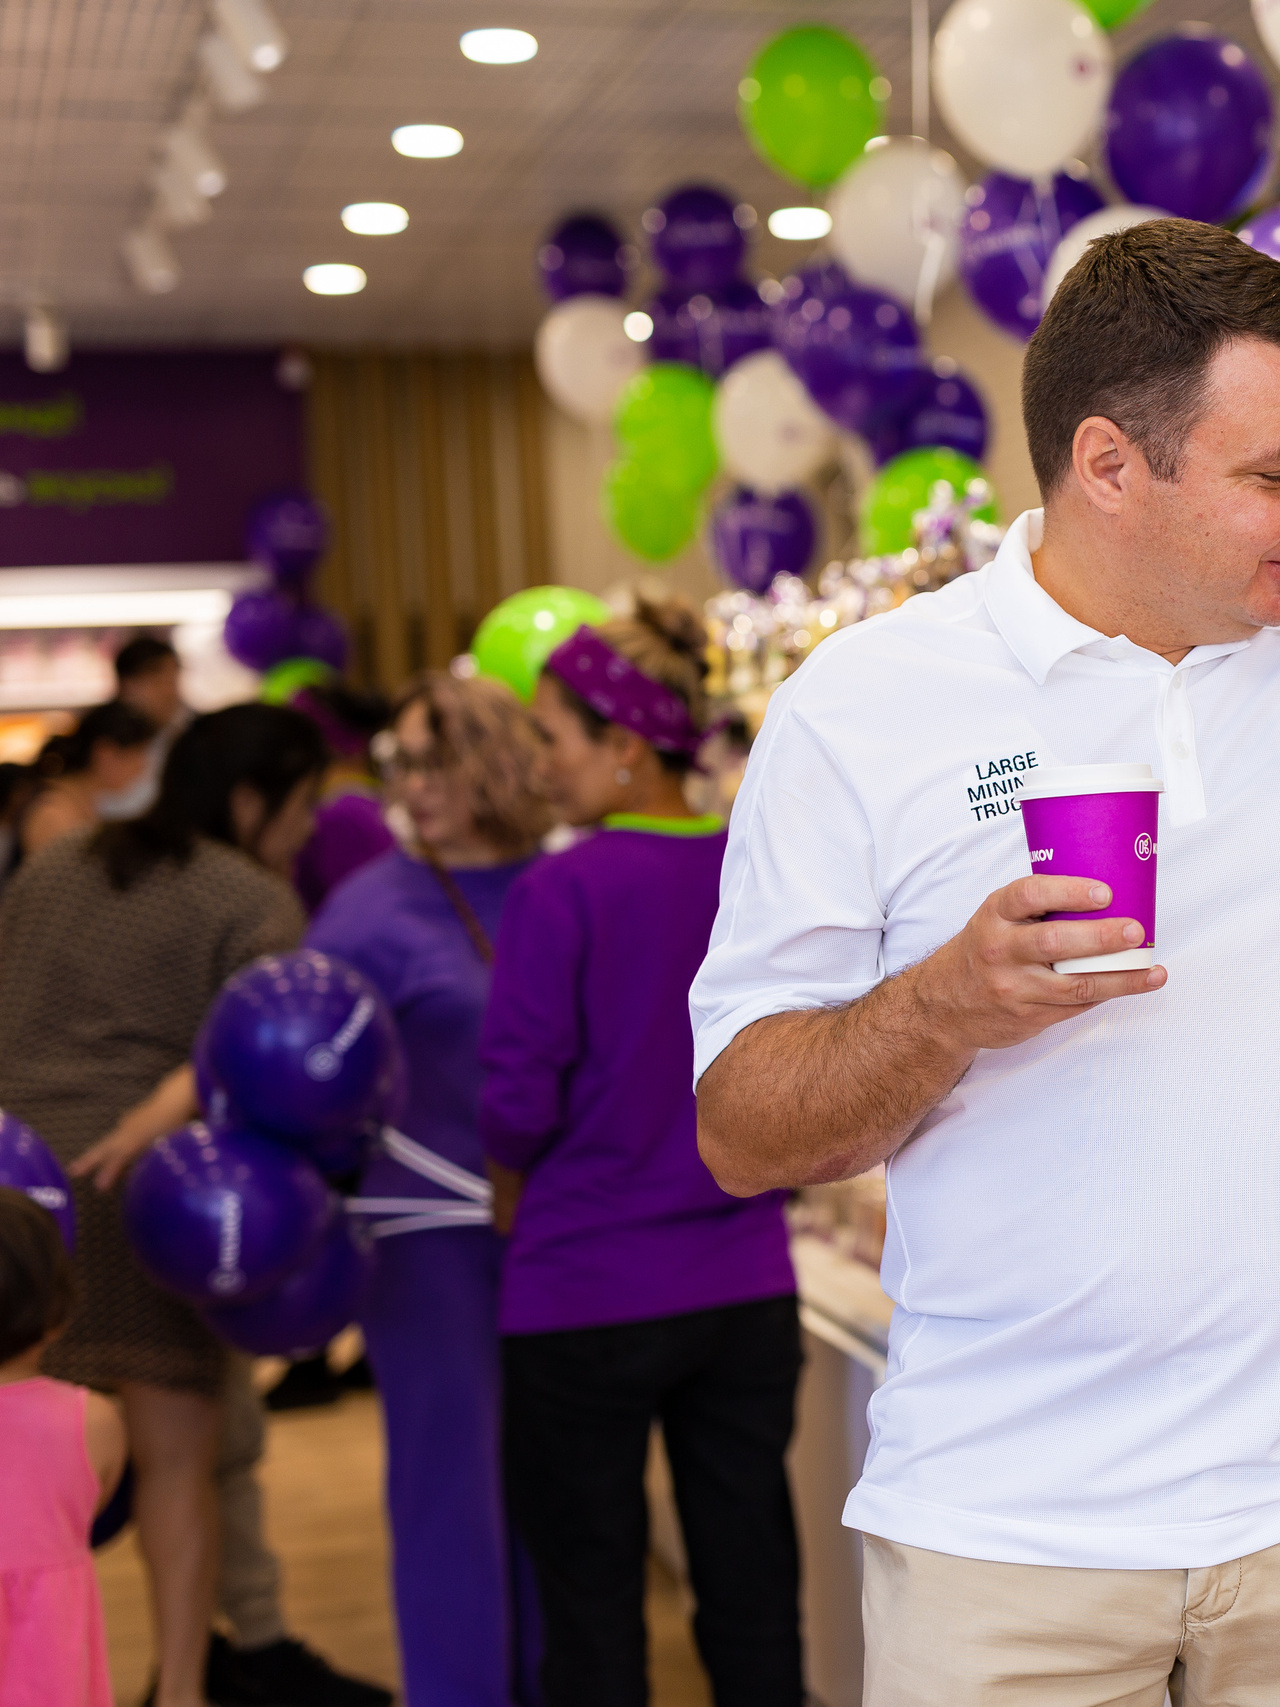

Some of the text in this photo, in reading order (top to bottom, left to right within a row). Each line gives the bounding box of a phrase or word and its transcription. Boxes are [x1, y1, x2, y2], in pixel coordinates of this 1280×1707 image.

[975, 751, 1039, 780] LARGE
[967, 775, 1025, 803] MININ
[970, 797, 1022, 821] TRUC
[1030, 848, 1054, 863] LIKOV
